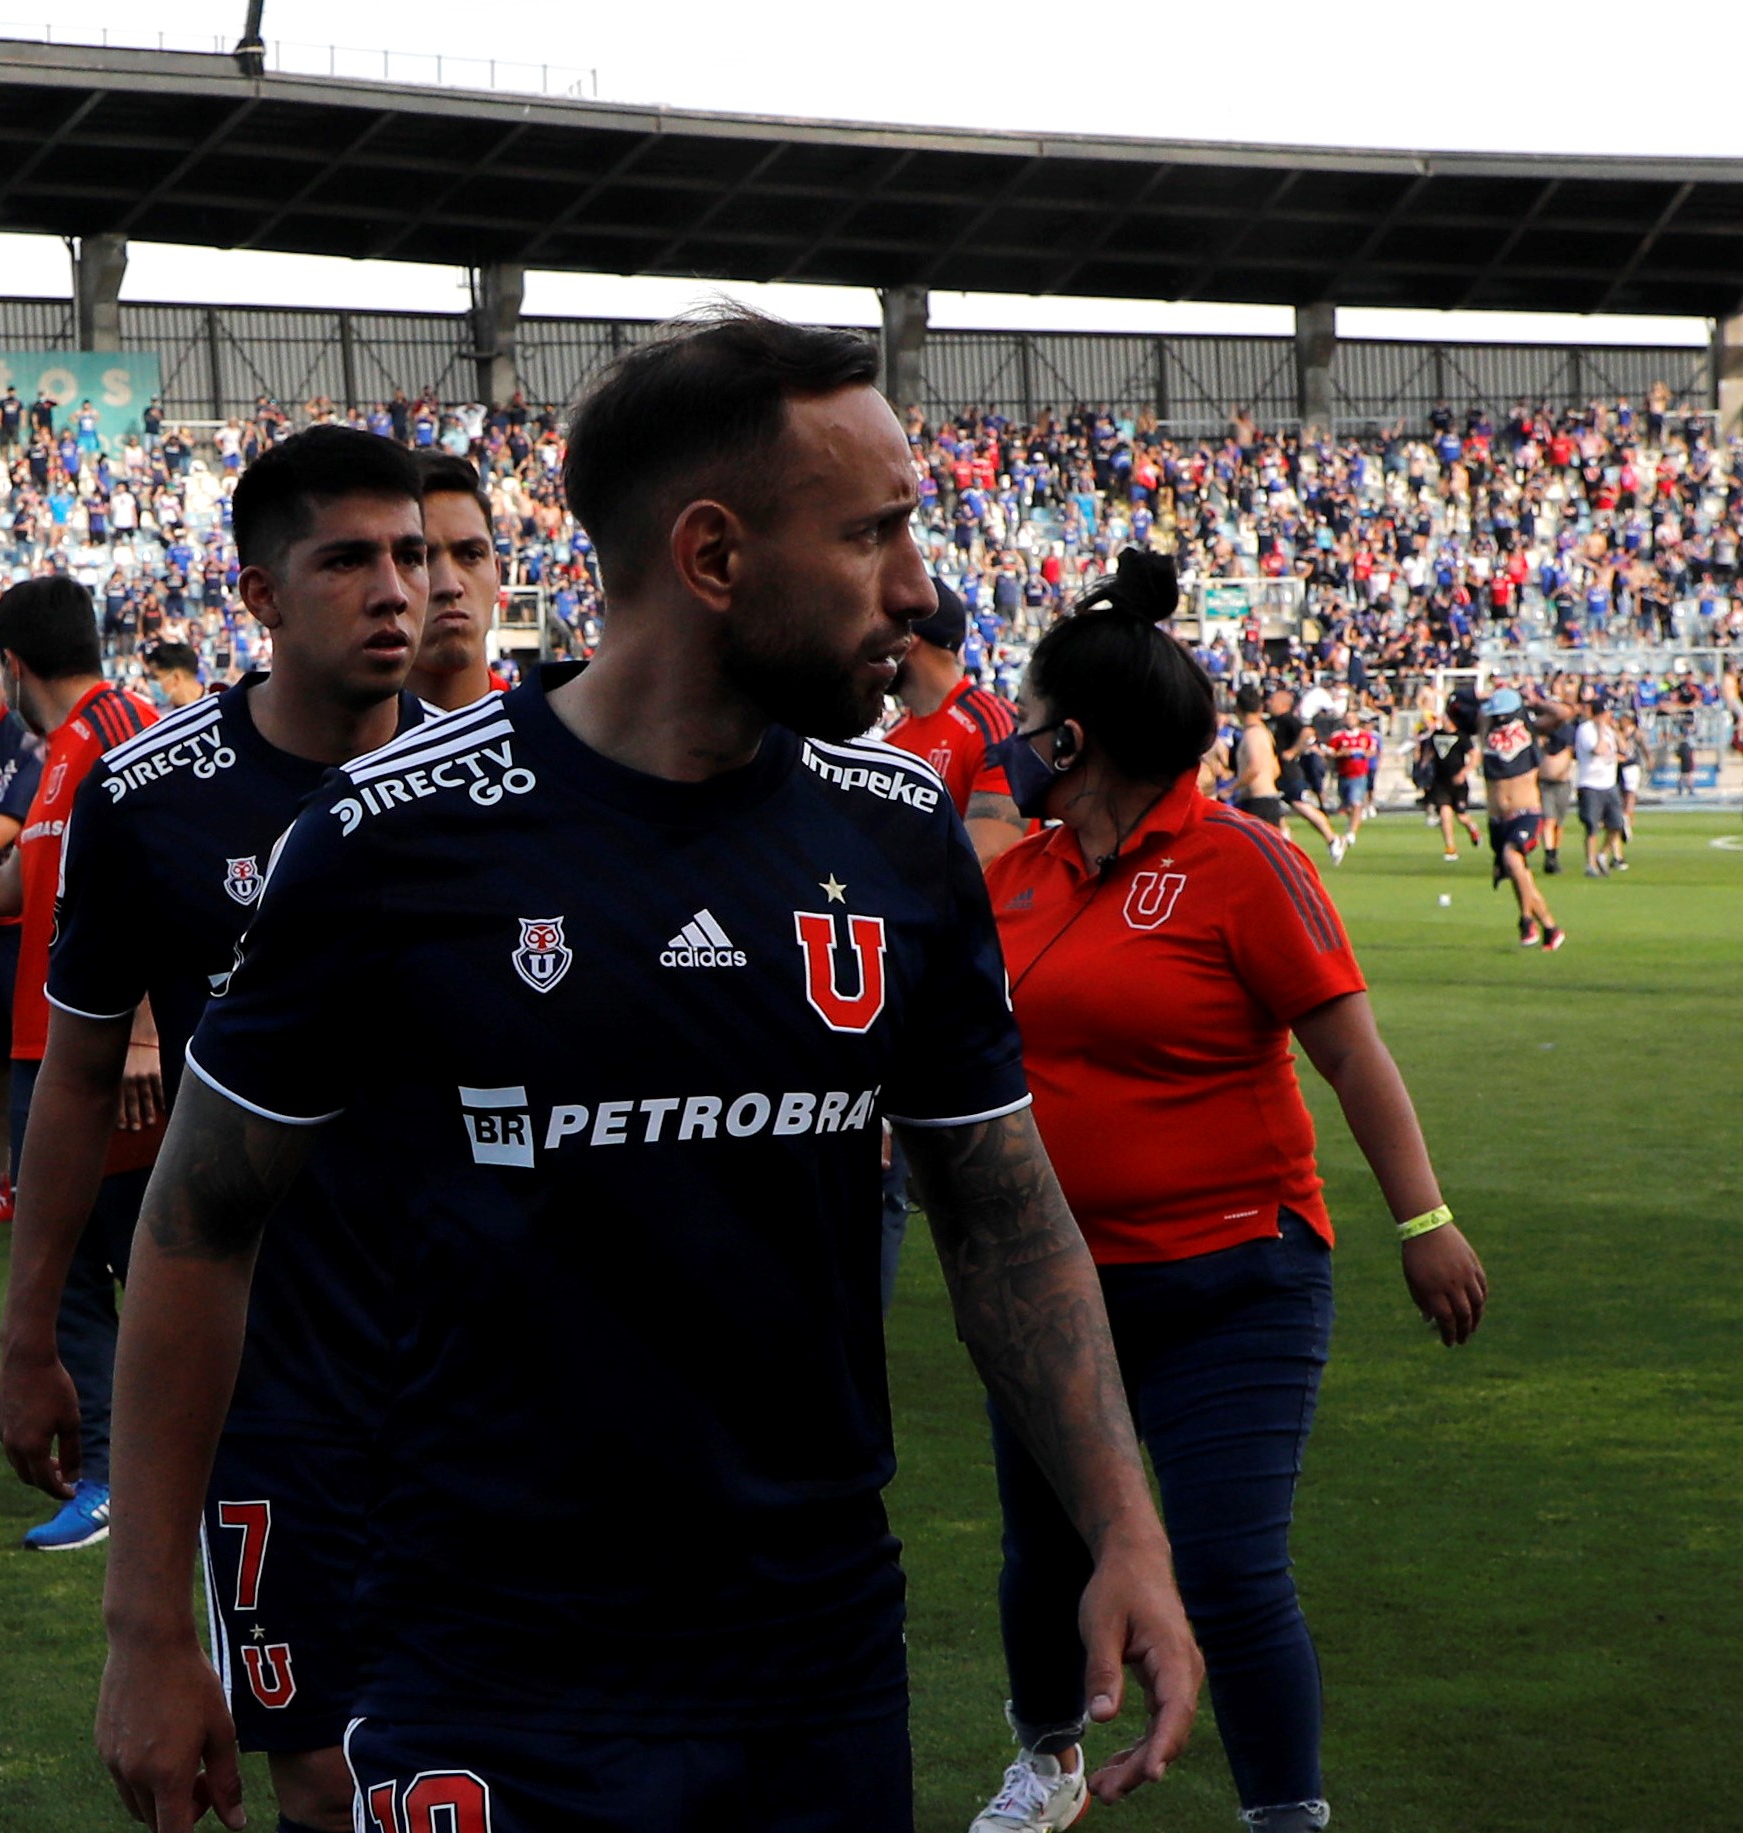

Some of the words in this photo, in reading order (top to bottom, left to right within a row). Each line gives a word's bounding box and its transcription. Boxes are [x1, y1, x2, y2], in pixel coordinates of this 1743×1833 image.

[102, 725, 222, 804] DIRECTV
[192, 749, 237, 779] GO
[330, 740, 515, 837] DIRECTV
[469, 766, 537, 806] GO
[802, 740, 941, 814] Impeke
[234, 879, 253, 896] U
[1122, 871, 1187, 930] U
[528, 953, 556, 978] U
[659, 944, 747, 969] adidas
[793, 910, 888, 1034] U
[475, 1115, 525, 1146] BR
[544, 1085, 882, 1149] PETROBRA
[218, 1500, 271, 1611] 7
[241, 1643, 297, 1709] U
